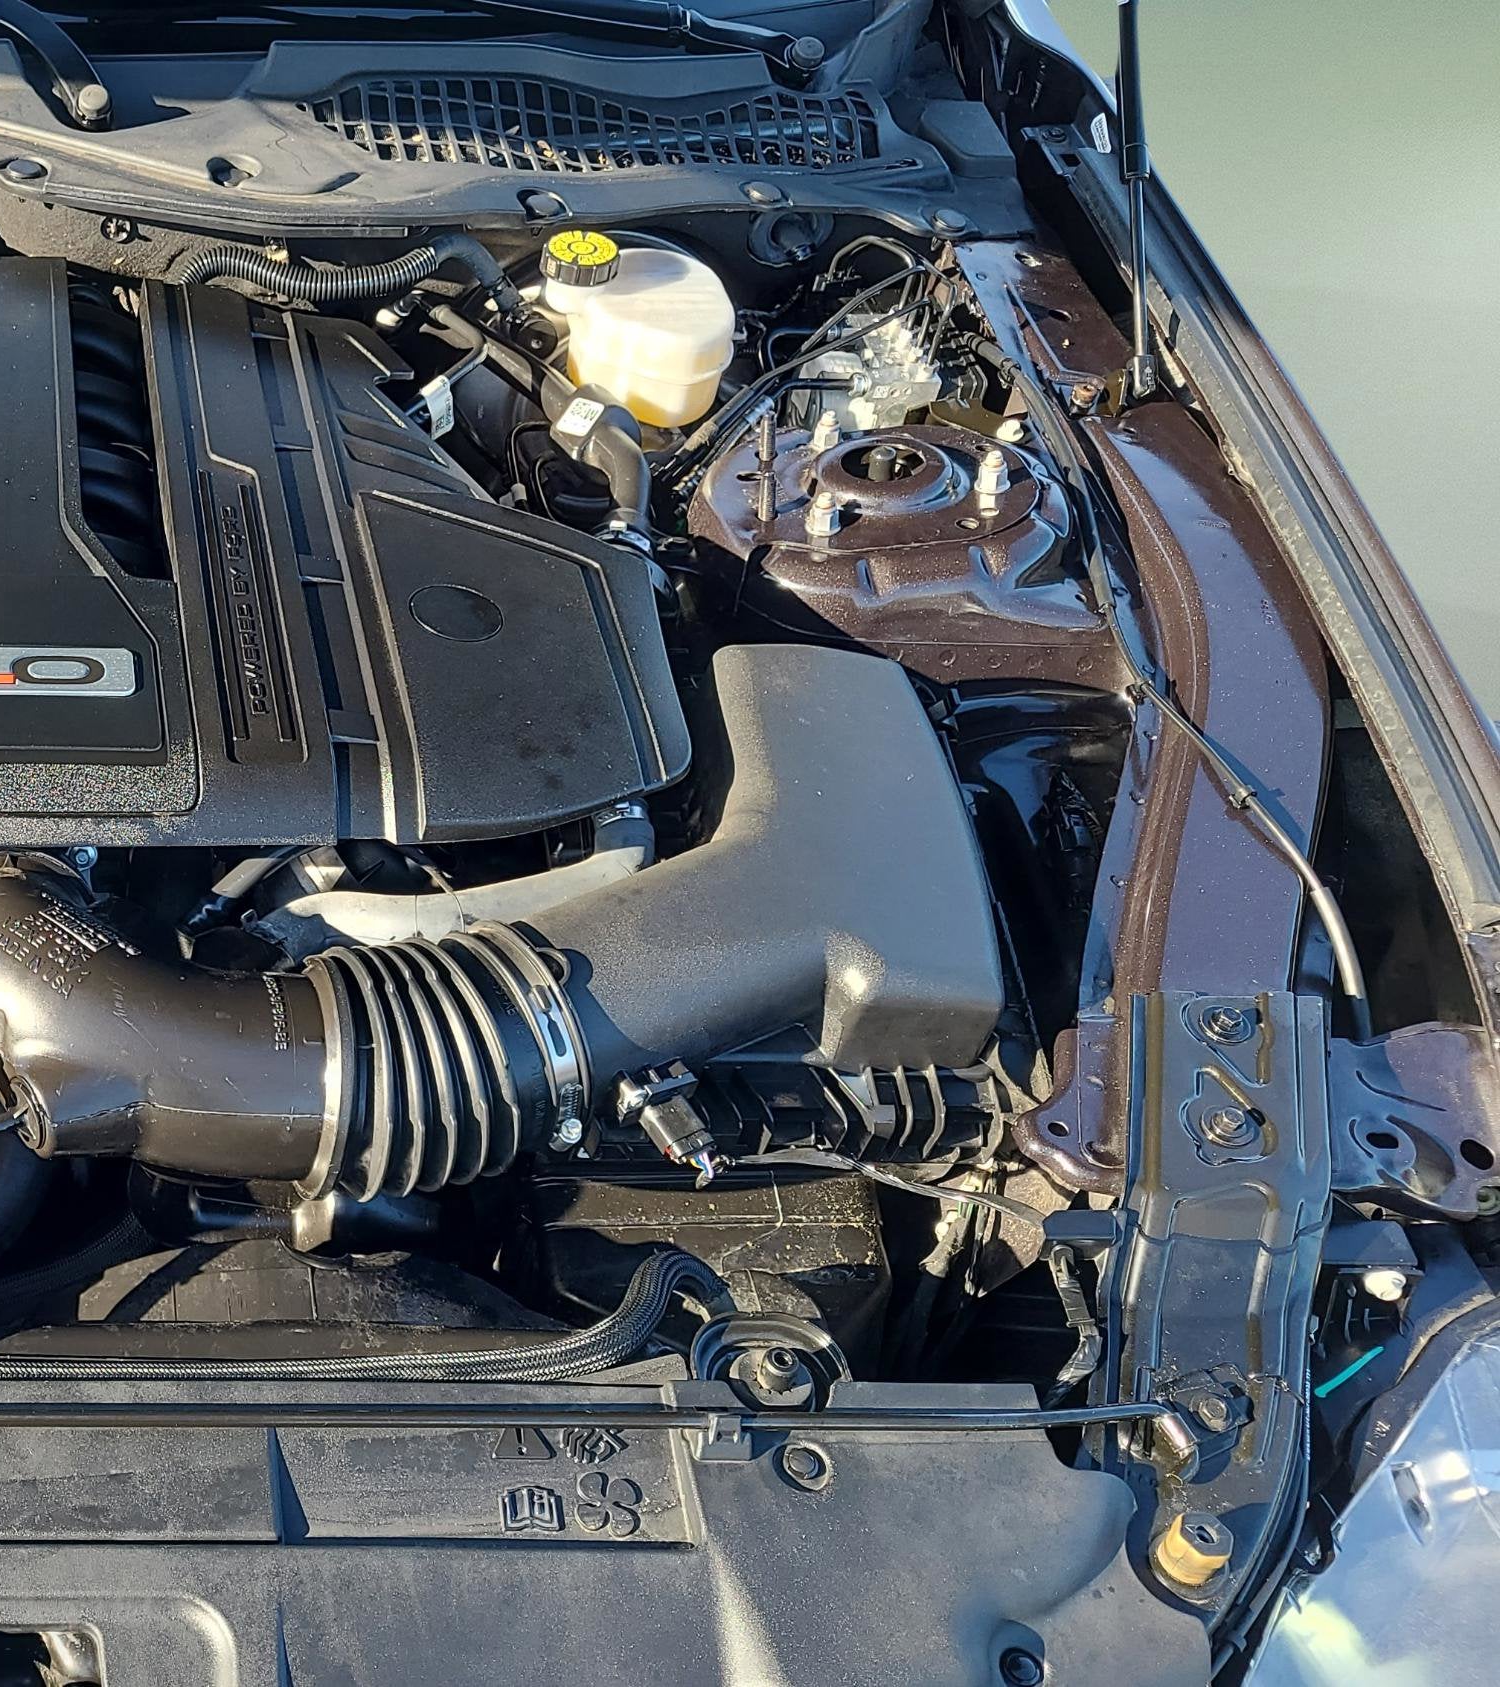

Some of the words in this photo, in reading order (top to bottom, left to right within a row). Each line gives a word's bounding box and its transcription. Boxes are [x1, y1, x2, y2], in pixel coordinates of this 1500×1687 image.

[220, 505, 244, 560] FORD
[229, 567, 249, 596] BY
[235, 602, 269, 715] POWERED
[42, 968, 74, 1001] USA
